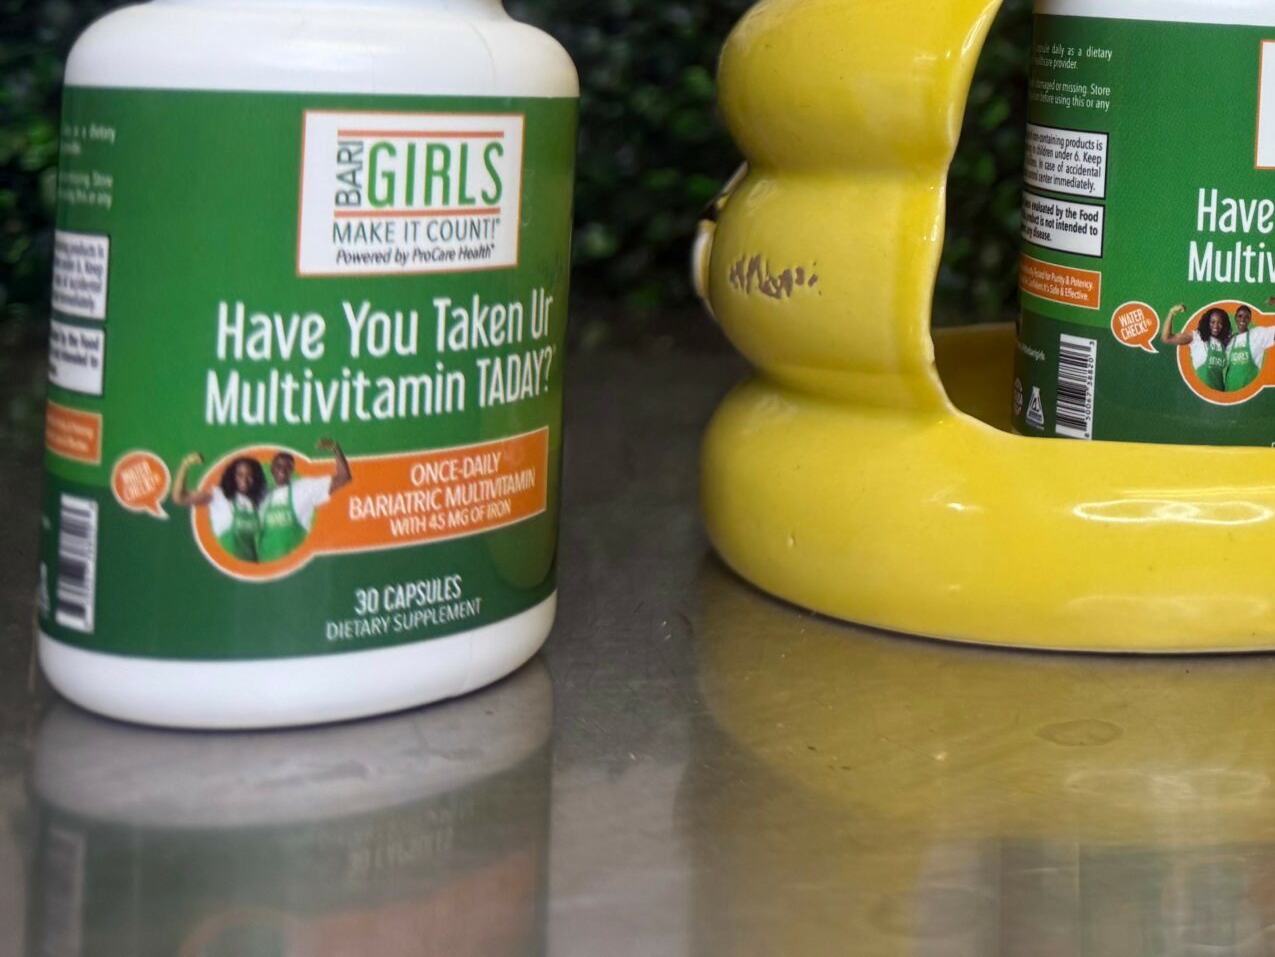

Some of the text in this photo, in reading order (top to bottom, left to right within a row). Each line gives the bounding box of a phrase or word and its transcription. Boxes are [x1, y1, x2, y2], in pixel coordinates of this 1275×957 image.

[1086, 46, 1113, 62] dietary
[1090, 82, 1111, 96] Store
[1055, 94, 1071, 109] using
[1072, 94, 1085, 107] this
[1086, 98, 1094, 108] or
[1095, 99, 1110, 113] any
[1065, 137, 1095, 151] products
[1096, 139, 1103, 151] is
[1055, 148, 1072, 160] under
[1082, 152, 1102, 167] Keep
[335, 141, 363, 207] BARI
[367, 142, 504, 208] GIRLS
[1065, 163, 1101, 178] accidental
[1053, 174, 1096, 193] immediately.
[1055, 205, 1063, 219] by
[1065, 207, 1077, 219] the
[1080, 210, 1099, 222] Food
[1197, 188, 1275, 234] Have
[333, 220, 395, 245] MAKE
[404, 220, 420, 242] IT
[1056, 220, 1087, 235] intended
[1089, 225, 1098, 236] to
[336, 247, 392, 265] Powered
[394, 248, 409, 267] by
[412, 246, 456, 262] ProCare
[216, 287, 554, 361] Have You Taken Ur
[1118, 309, 1145, 327] WATER
[205, 346, 553, 426] Multivitamin TADAY?
[410, 451, 501, 487] ONCE-DAILY
[349, 467, 536, 520] BARIATRIC MULTIVITAMIN
[390, 499, 511, 537] WITH 45 MG OF IRON
[354, 574, 462, 616] 30 CAPSULES
[326, 597, 482, 641] DIETARY SUPPLEMENT
